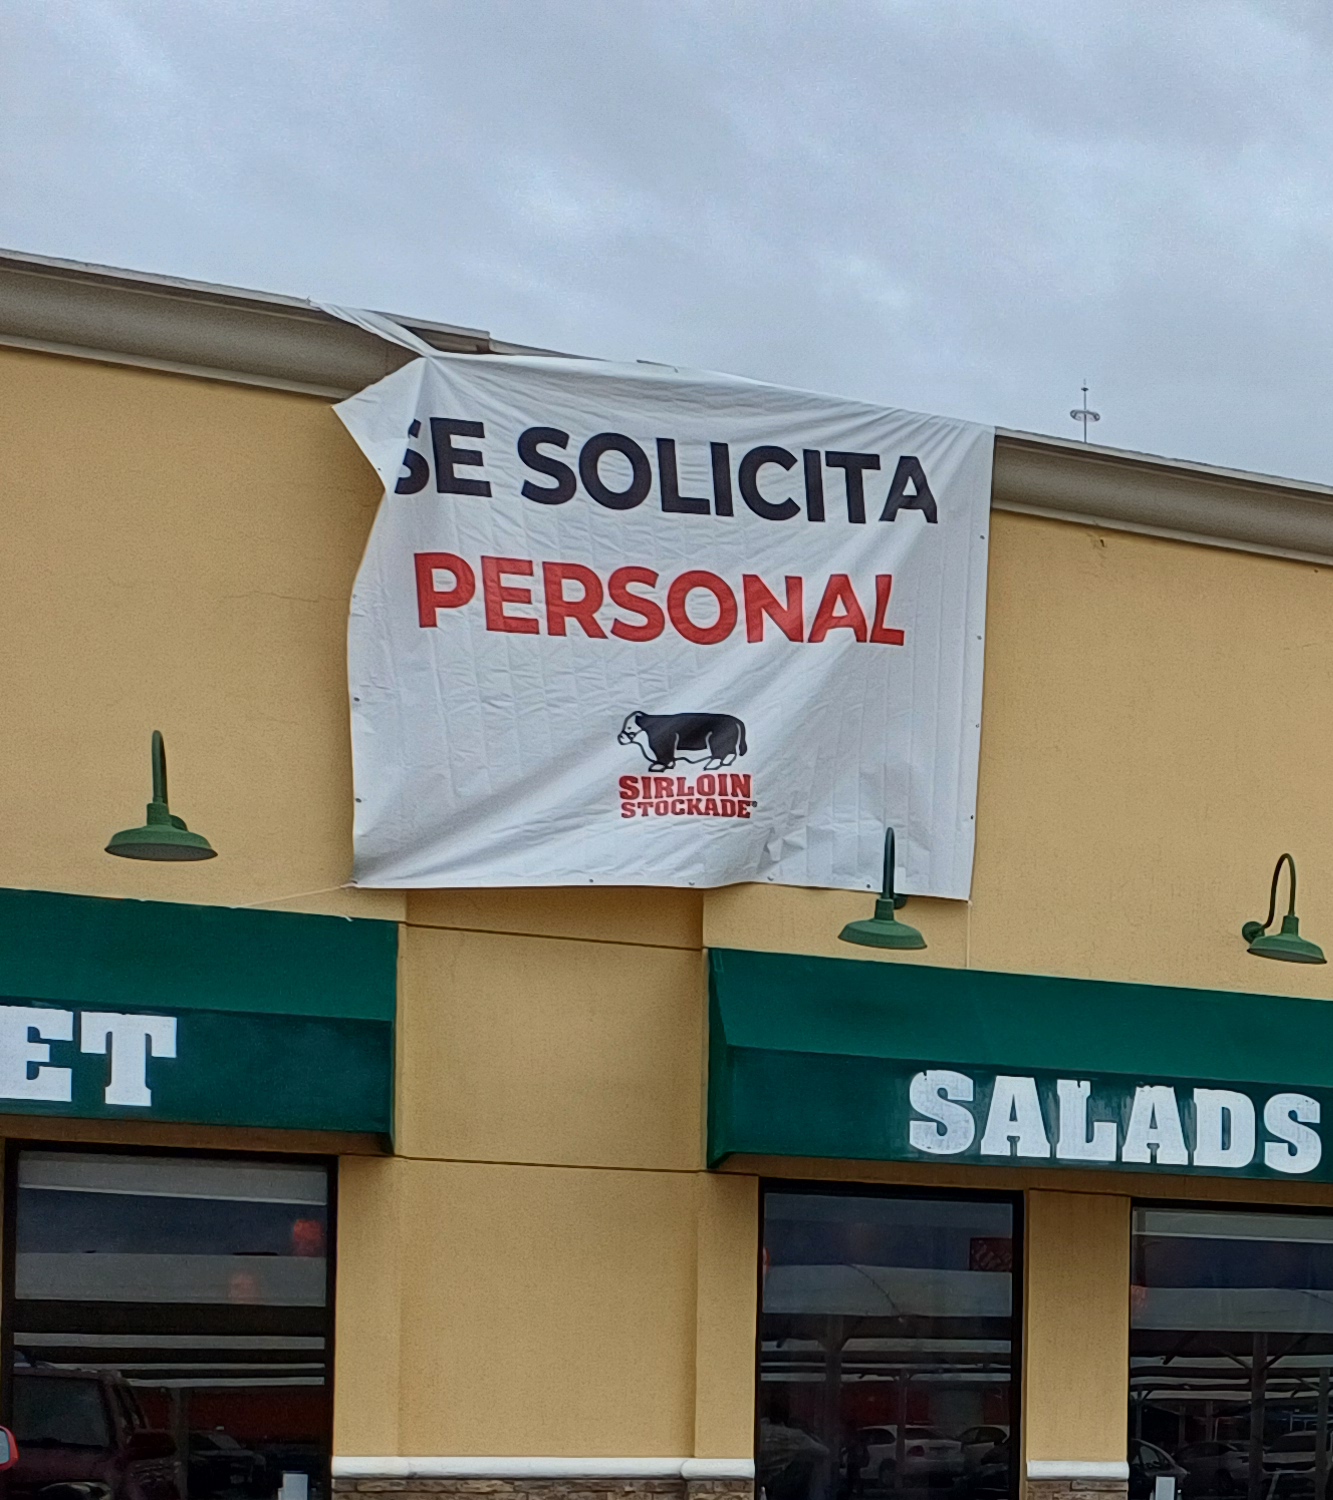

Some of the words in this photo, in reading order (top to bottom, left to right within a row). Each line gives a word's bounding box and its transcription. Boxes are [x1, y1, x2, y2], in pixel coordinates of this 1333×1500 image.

[516, 426, 938, 524] SOLICITA
[413, 551, 905, 646] PERSONAL
[619, 773, 752, 800] SIRLOIN
[621, 798, 751, 819] STOCKADE
[908, 1069, 1323, 1174] SALADS
